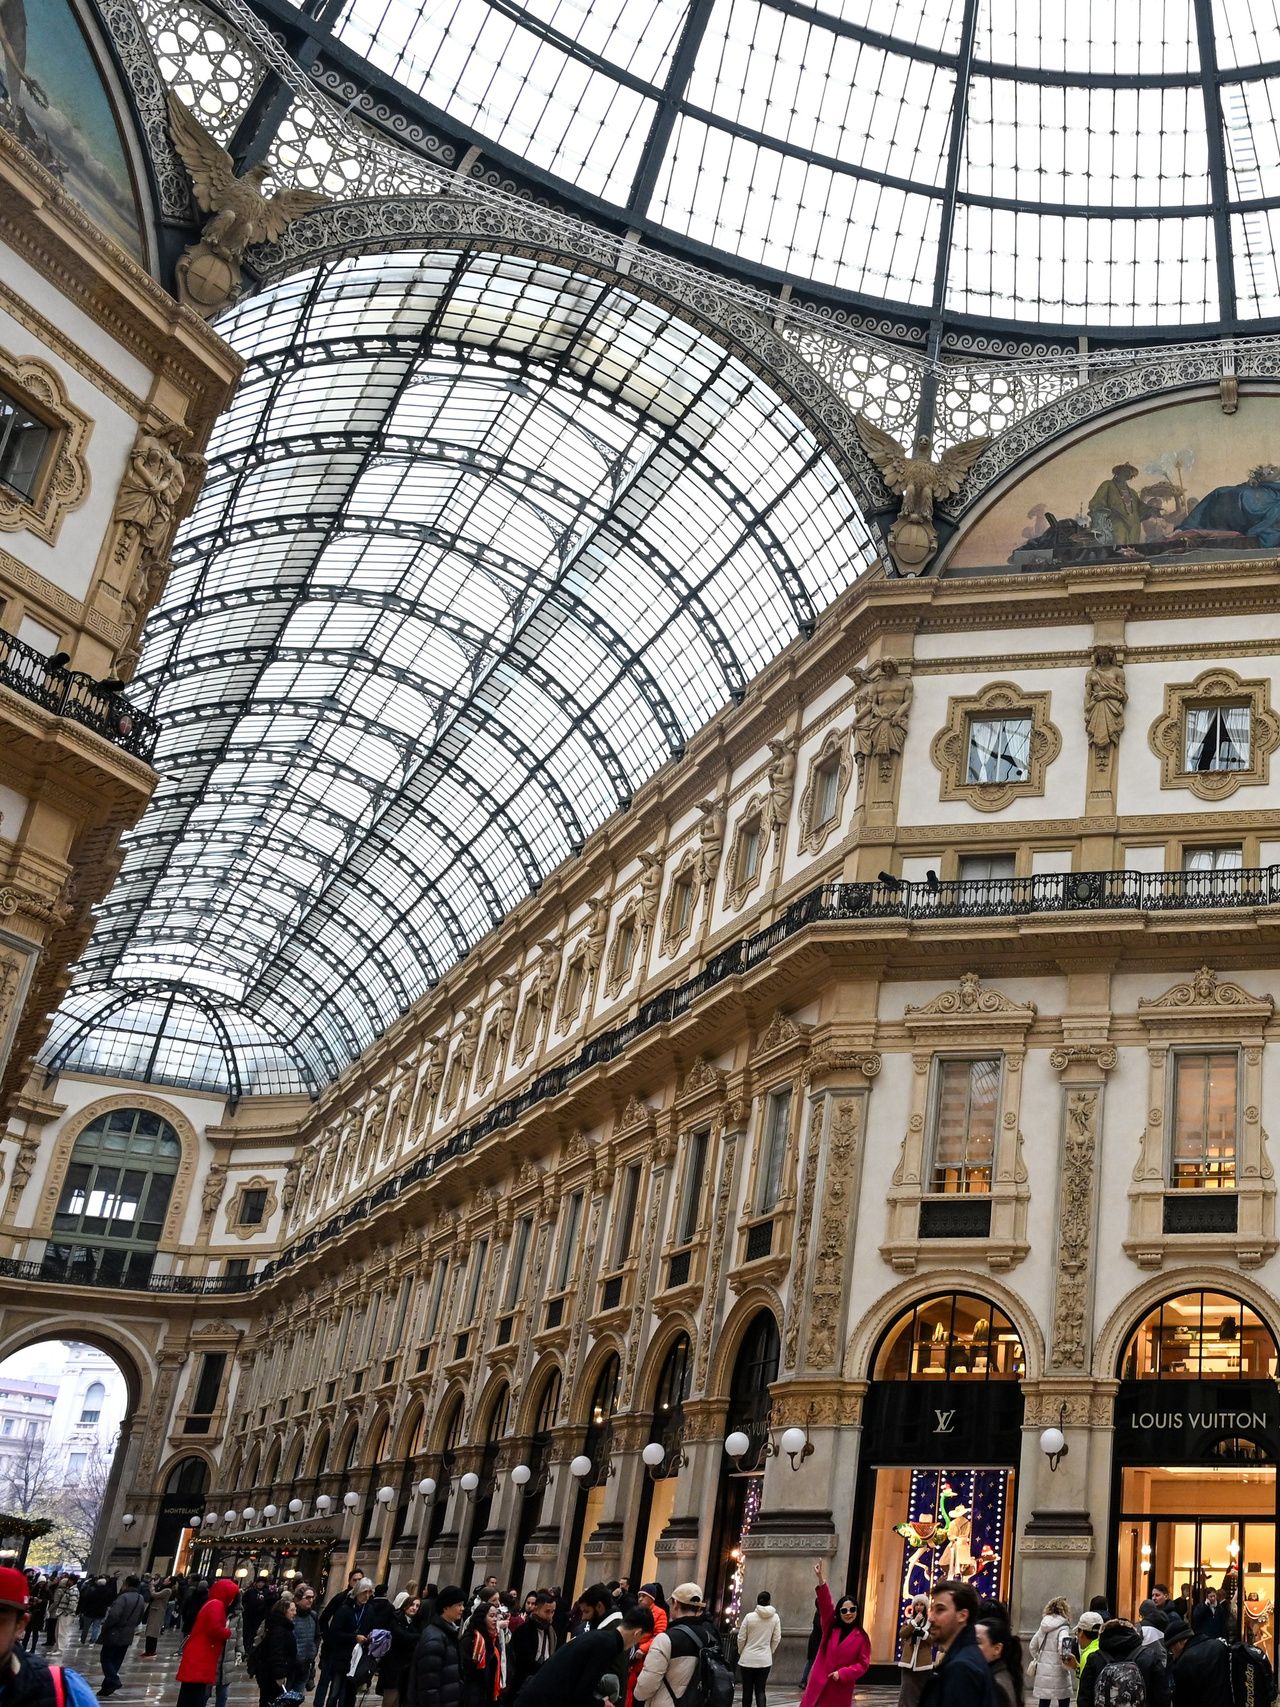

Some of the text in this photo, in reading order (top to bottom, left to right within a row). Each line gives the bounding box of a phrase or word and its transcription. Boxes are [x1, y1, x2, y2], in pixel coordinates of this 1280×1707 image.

[1131, 1412, 1267, 1429] LOUIS VUITTON
[302, 1524, 334, 1534] Salotto
